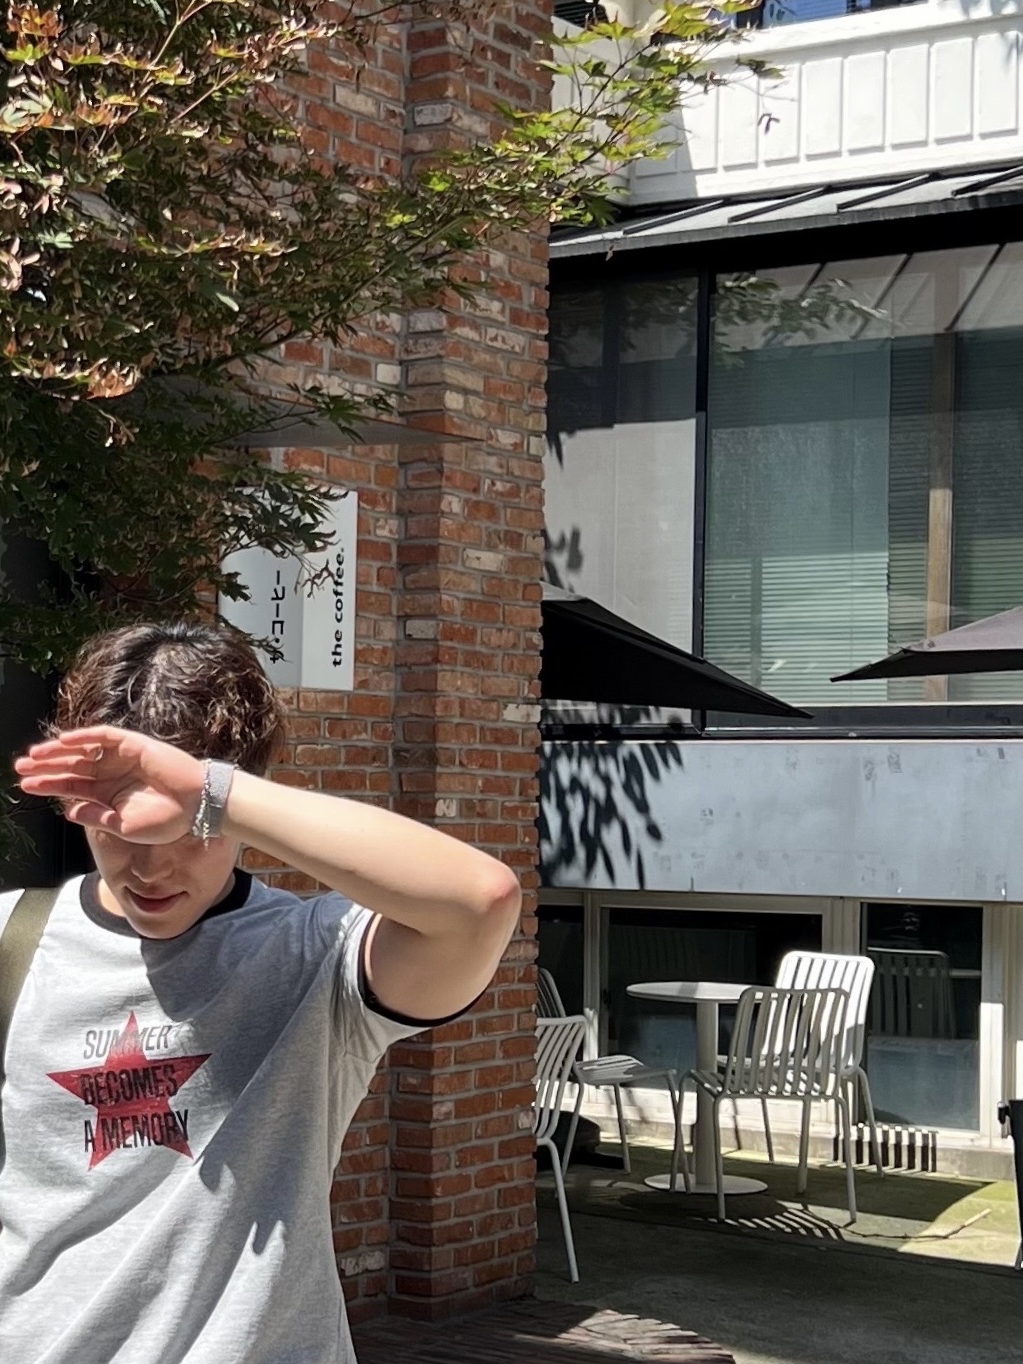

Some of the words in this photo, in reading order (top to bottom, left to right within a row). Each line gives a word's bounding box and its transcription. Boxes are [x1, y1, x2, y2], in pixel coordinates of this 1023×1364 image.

[332, 547, 344, 623] coffee.
[331, 630, 343, 667] the
[80, 1064, 178, 1105] BECOMES
[84, 1119, 96, 1153] A
[101, 1109, 189, 1150] MEMORY
